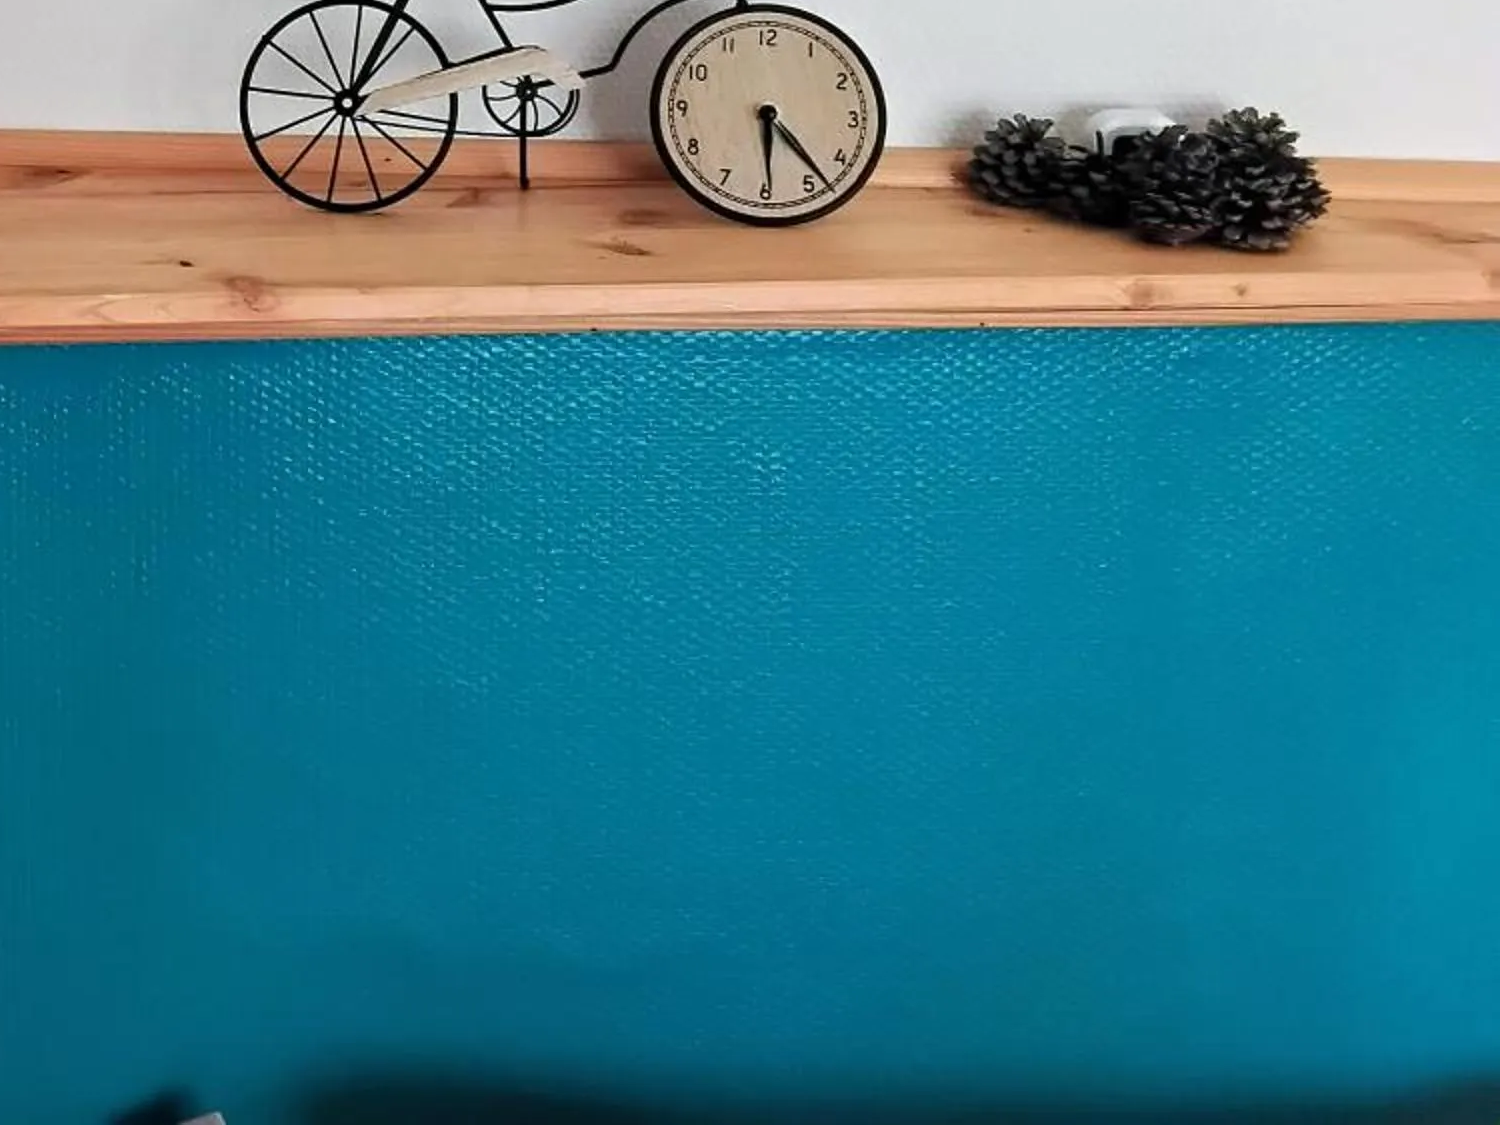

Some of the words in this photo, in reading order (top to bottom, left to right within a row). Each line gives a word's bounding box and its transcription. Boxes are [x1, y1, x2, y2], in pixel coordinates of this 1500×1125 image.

[722, 37, 735, 54] 11
[758, 28, 777, 47] 12
[807, 42, 814, 58] 1
[688, 63, 708, 82] 10
[836, 72, 848, 91] 2
[676, 100, 688, 118] 9
[848, 110, 859, 129] 3
[687, 138, 700, 156] 8
[834, 148, 847, 166] 4
[719, 168, 732, 186] 7
[802, 175, 815, 193] 5
[759, 181, 772, 200] 6
